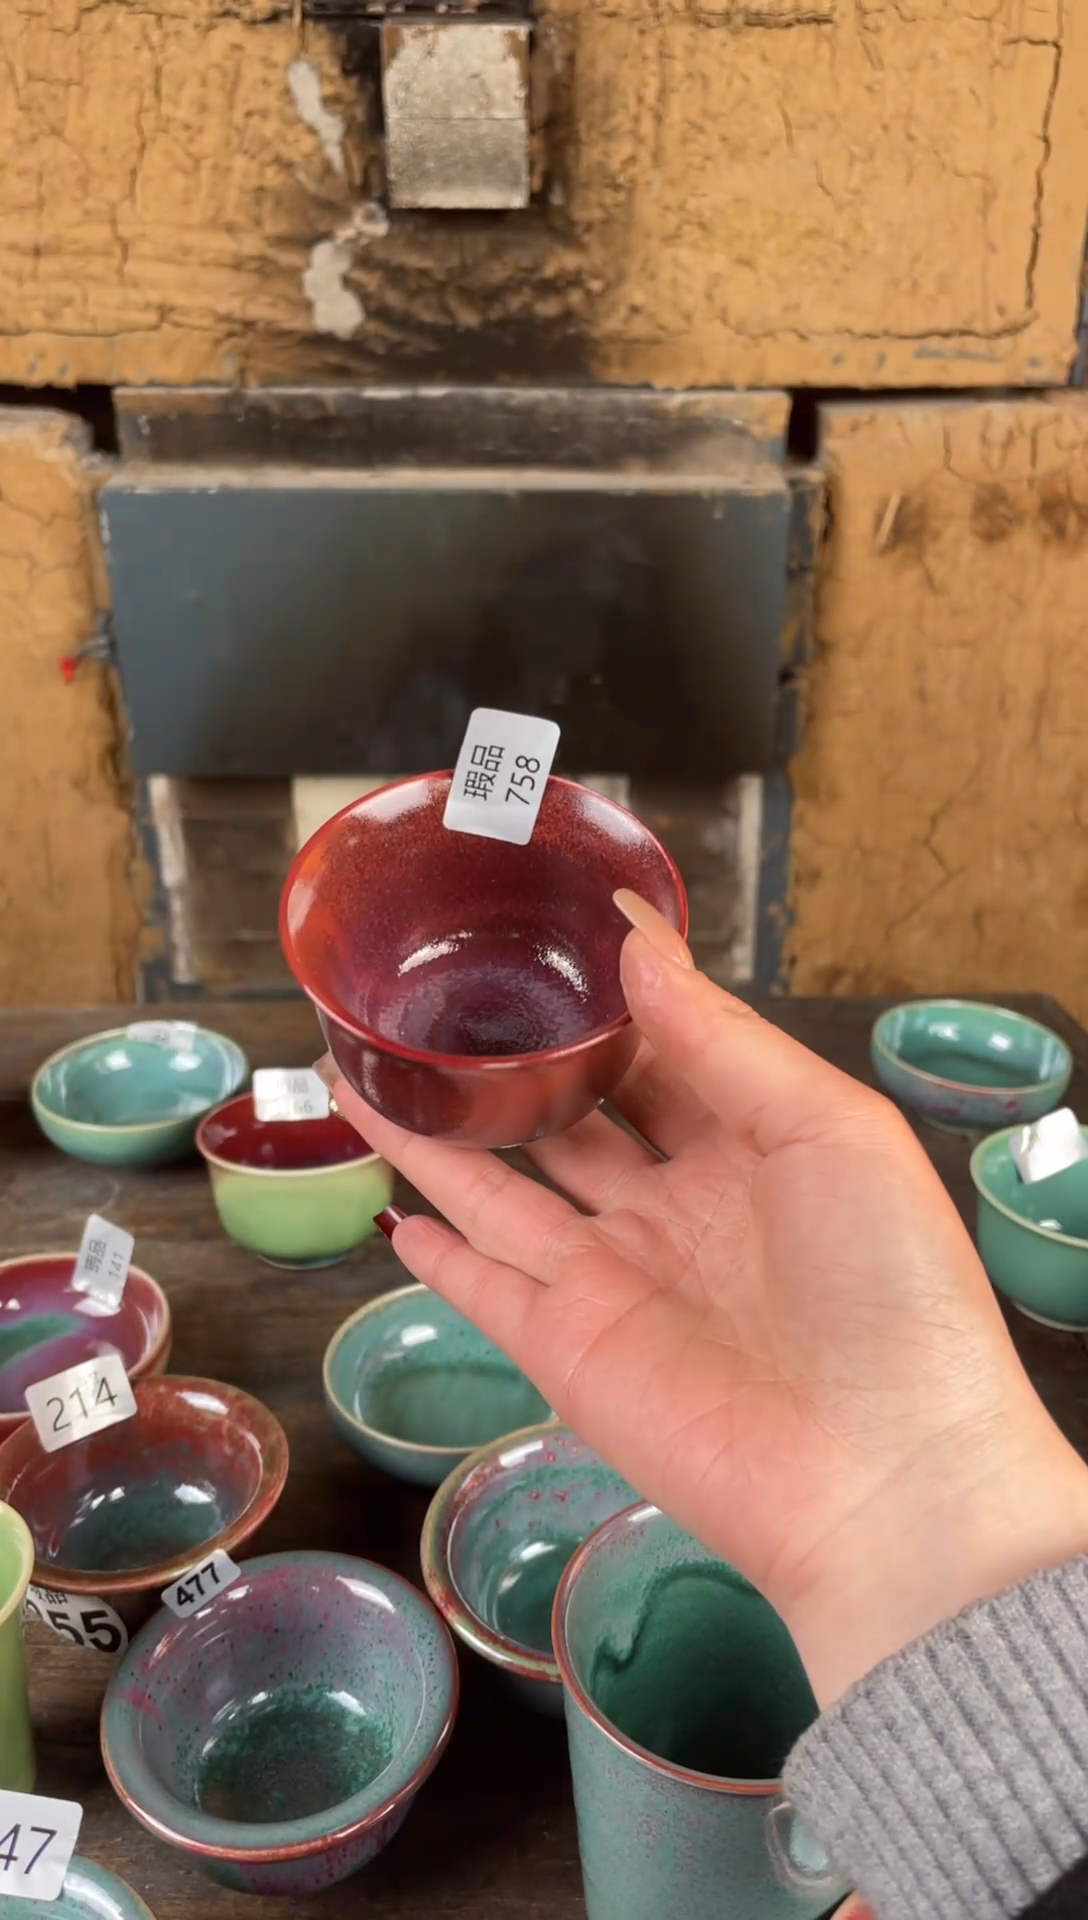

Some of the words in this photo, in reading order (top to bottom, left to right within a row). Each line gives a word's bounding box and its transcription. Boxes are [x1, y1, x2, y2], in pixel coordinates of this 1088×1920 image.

[463, 744, 505, 801] 瑕品
[505, 755, 541, 805] 758
[277, 1075, 309, 1094] 品
[107, 1251, 124, 1279] 141
[46, 1376, 118, 1433] 214
[176, 1561, 221, 1607] 477
[0, 1823, 58, 1875] 47
